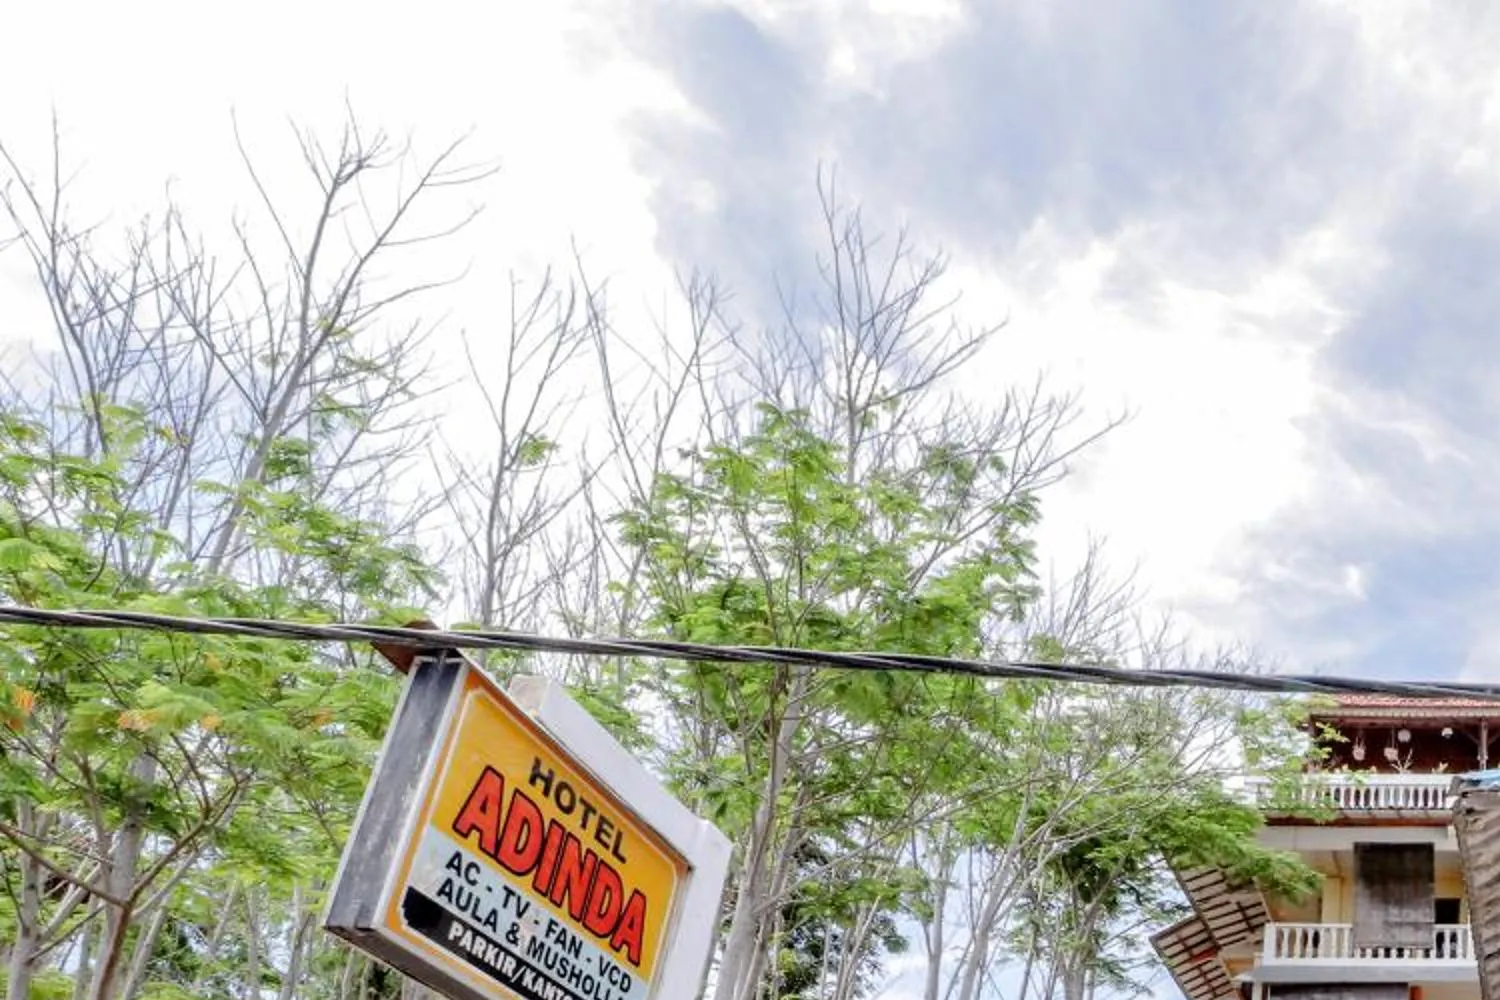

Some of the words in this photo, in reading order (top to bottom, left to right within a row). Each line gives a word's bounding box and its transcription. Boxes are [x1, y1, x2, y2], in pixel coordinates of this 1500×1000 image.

[452, 765, 646, 967] ADINDA
[528, 756, 627, 864] HOTEL
[436, 878, 498, 932] AULA
[506, 922, 520, 946] &
[446, 851, 481, 886] AC
[502, 886, 531, 919] TV
[545, 918, 583, 960] FAN
[599, 955, 631, 993] VCD
